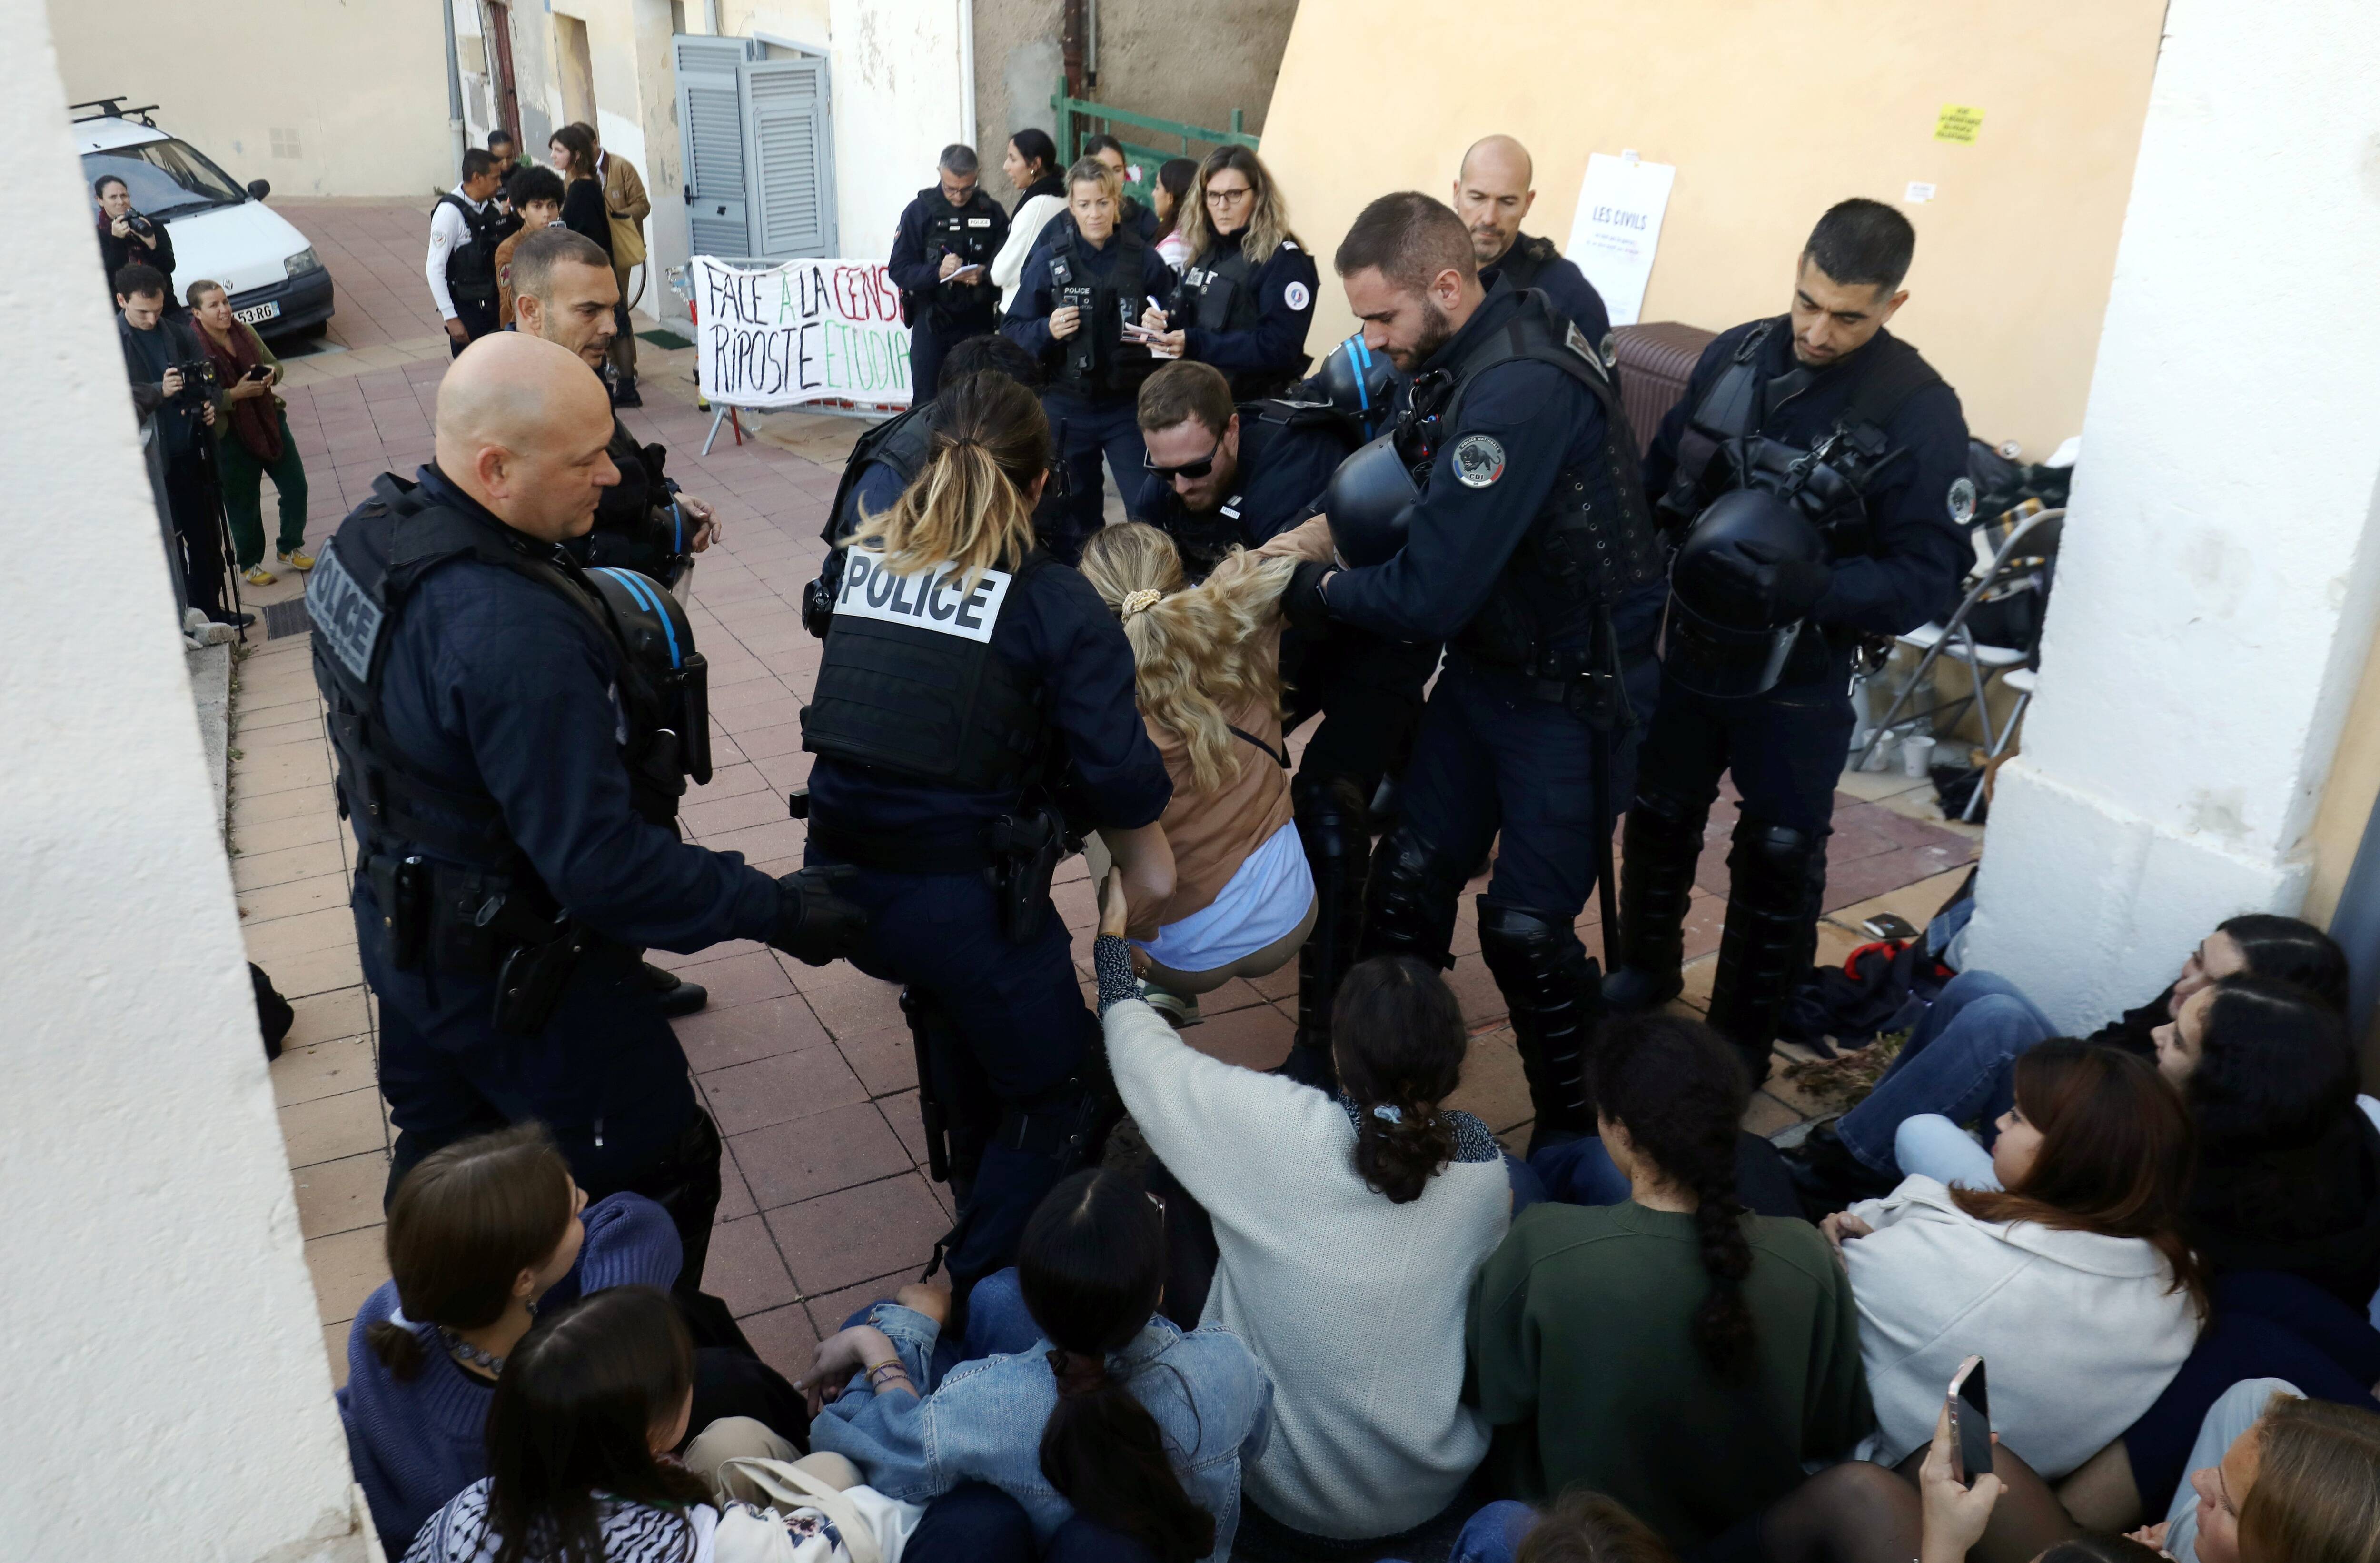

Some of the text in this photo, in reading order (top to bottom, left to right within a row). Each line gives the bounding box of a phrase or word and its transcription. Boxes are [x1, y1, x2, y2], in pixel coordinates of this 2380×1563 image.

[1593, 205, 1613, 223] LES
[800, 265, 831, 318] LA
[833, 263, 906, 323] CENS
[232, 305, 272, 323] 53-RG
[1461, 437, 1501, 451] POLICE NATIONALE
[841, 555, 996, 630] POLICE
